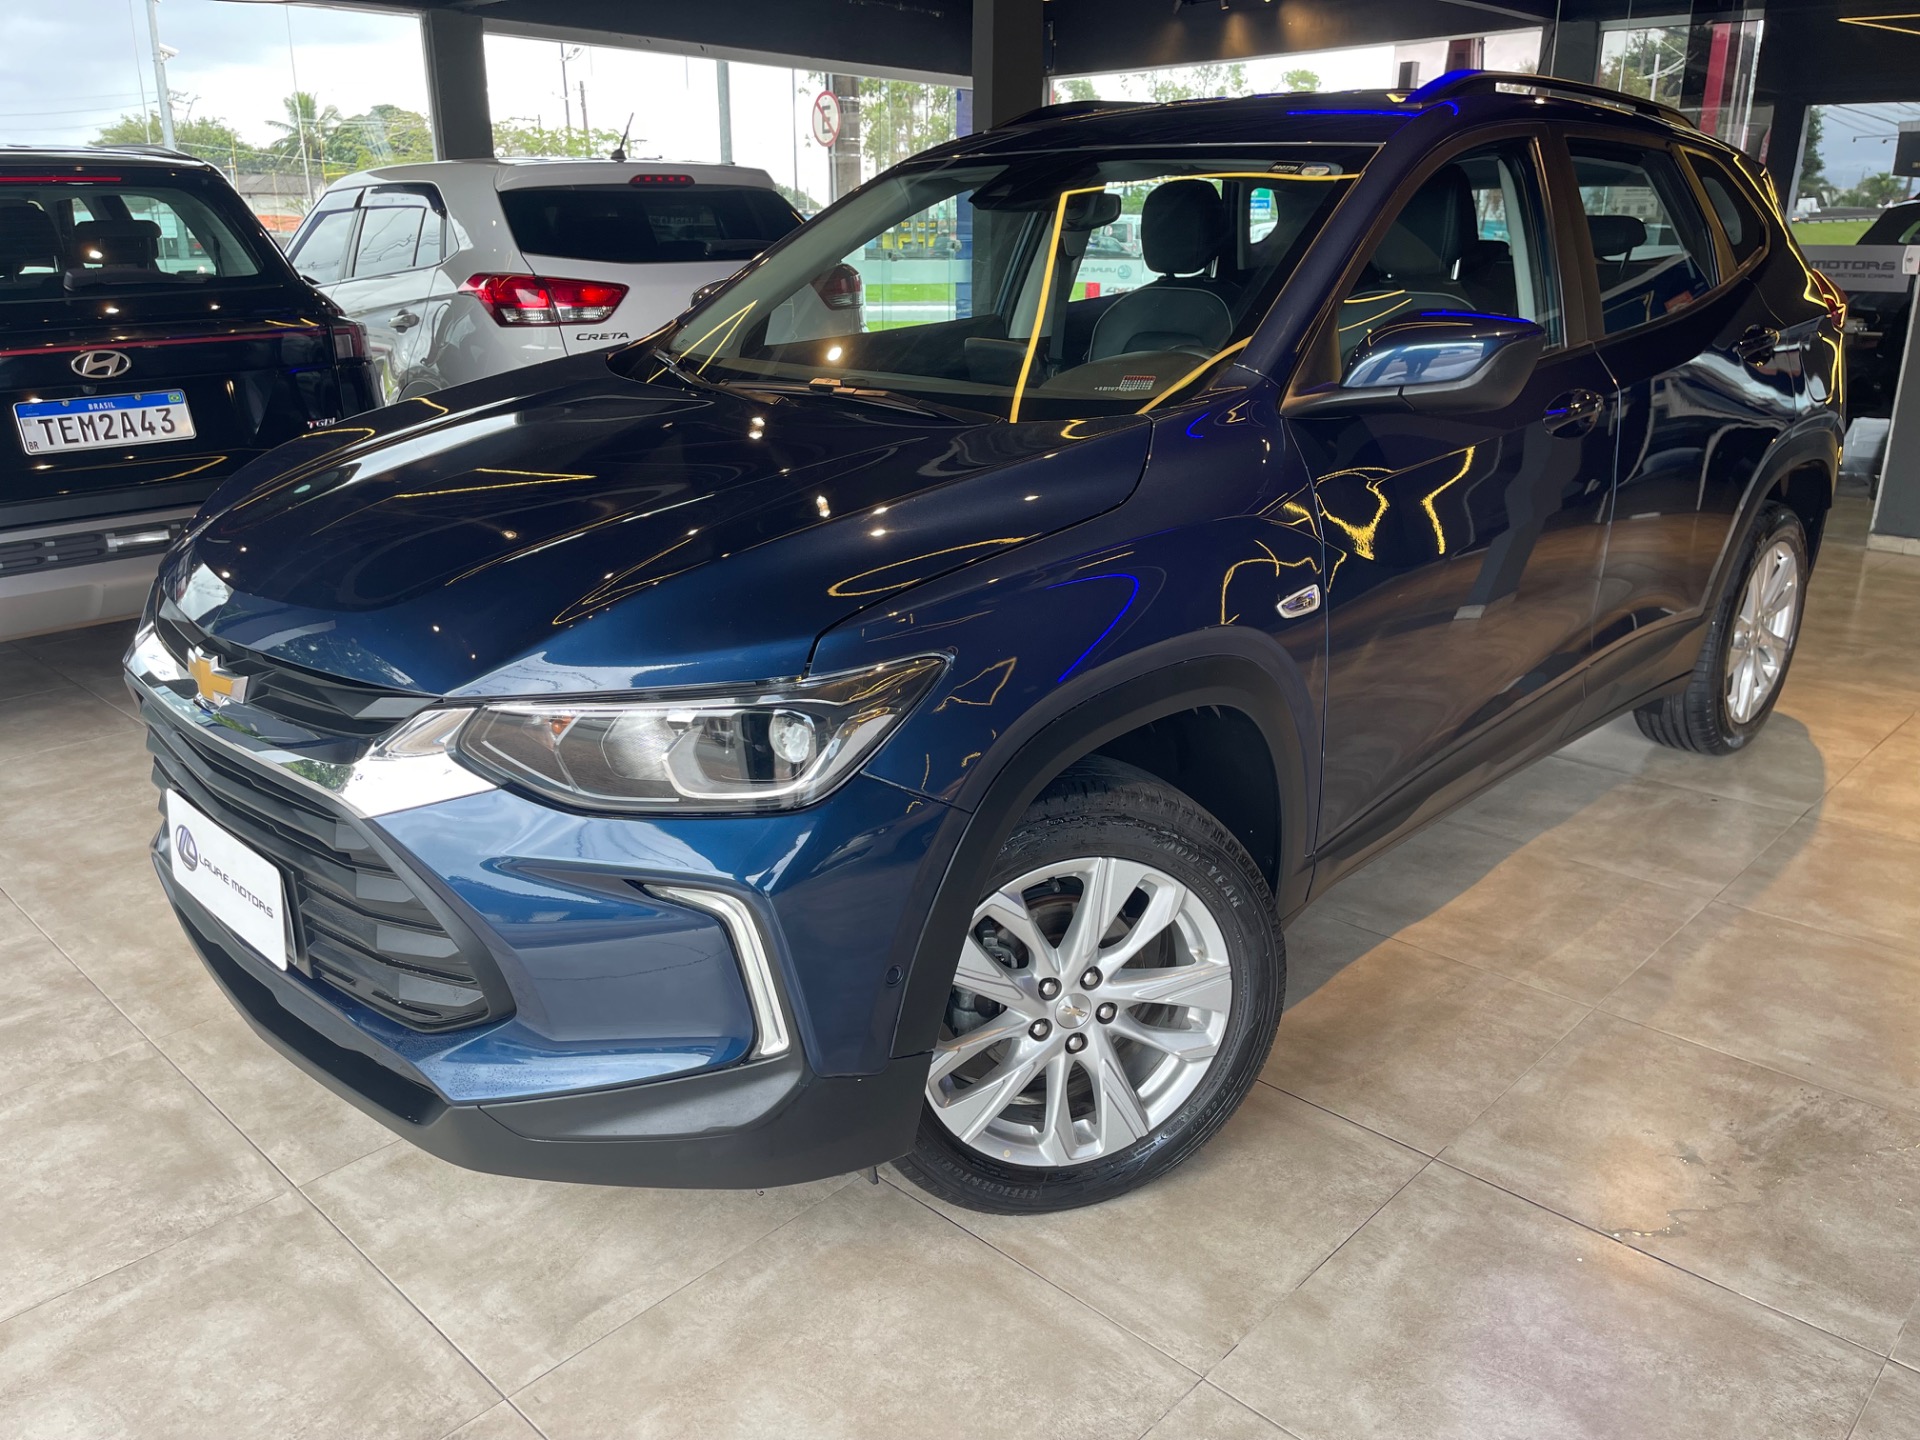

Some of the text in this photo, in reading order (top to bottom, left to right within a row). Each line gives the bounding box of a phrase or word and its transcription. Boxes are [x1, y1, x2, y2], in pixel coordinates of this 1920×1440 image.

[1811, 260, 1896, 270] MOTORS
[575, 332, 630, 341] CRETA
[87, 401, 116, 411] BRASIL
[36, 407, 176, 446] TEM2A43
[28, 441, 40, 451] BR
[198, 853, 274, 919] LAURE MOTORS
